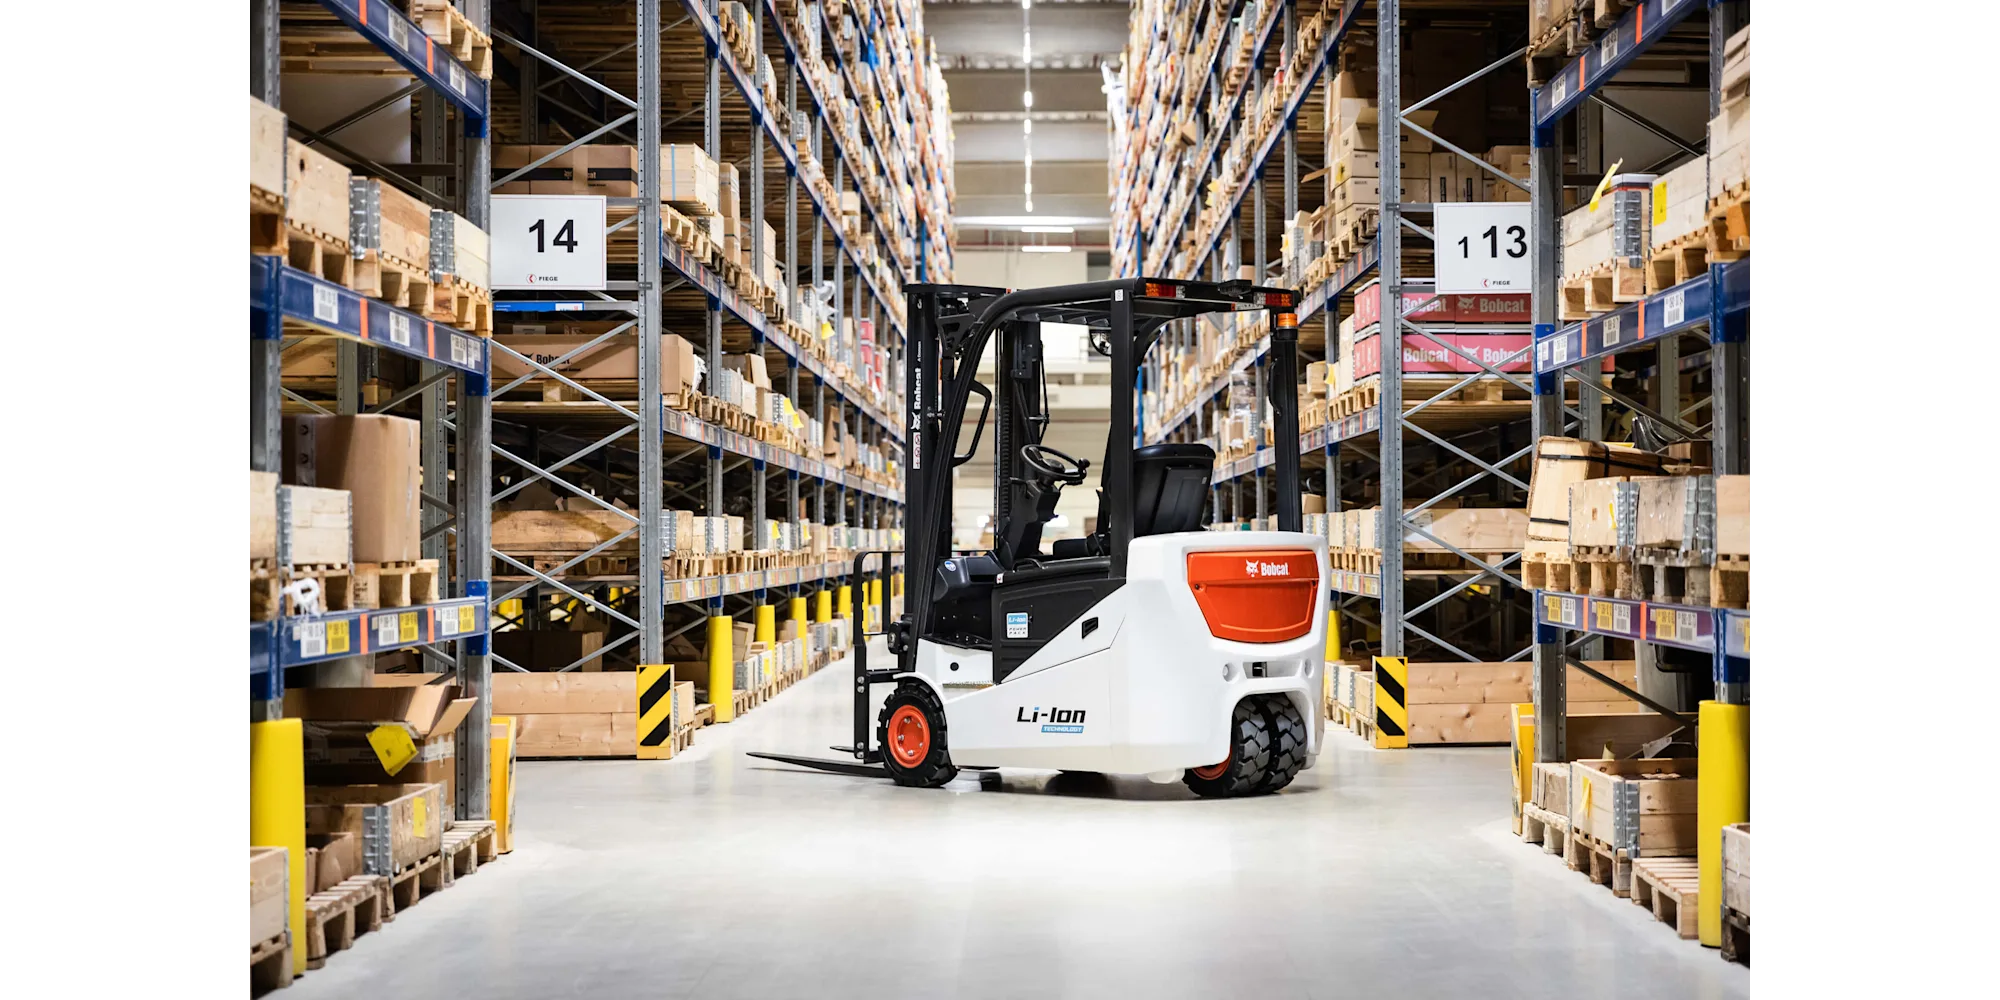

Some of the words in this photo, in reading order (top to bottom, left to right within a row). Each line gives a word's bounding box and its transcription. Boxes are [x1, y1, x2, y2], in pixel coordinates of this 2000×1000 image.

[529, 219, 578, 253] 14
[1458, 236, 1468, 259] 1
[1482, 225, 1527, 259] 13
[1402, 297, 1447, 313] Bobcat
[1479, 298, 1525, 313] Bobcat
[1403, 348, 1449, 363] Bobcat
[913, 367, 922, 410] Bobcat
[1260, 562, 1289, 576] Bobcat
[1017, 706, 1086, 723] Li-Ion
[1043, 725, 1083, 733] TECHNOLOGY
